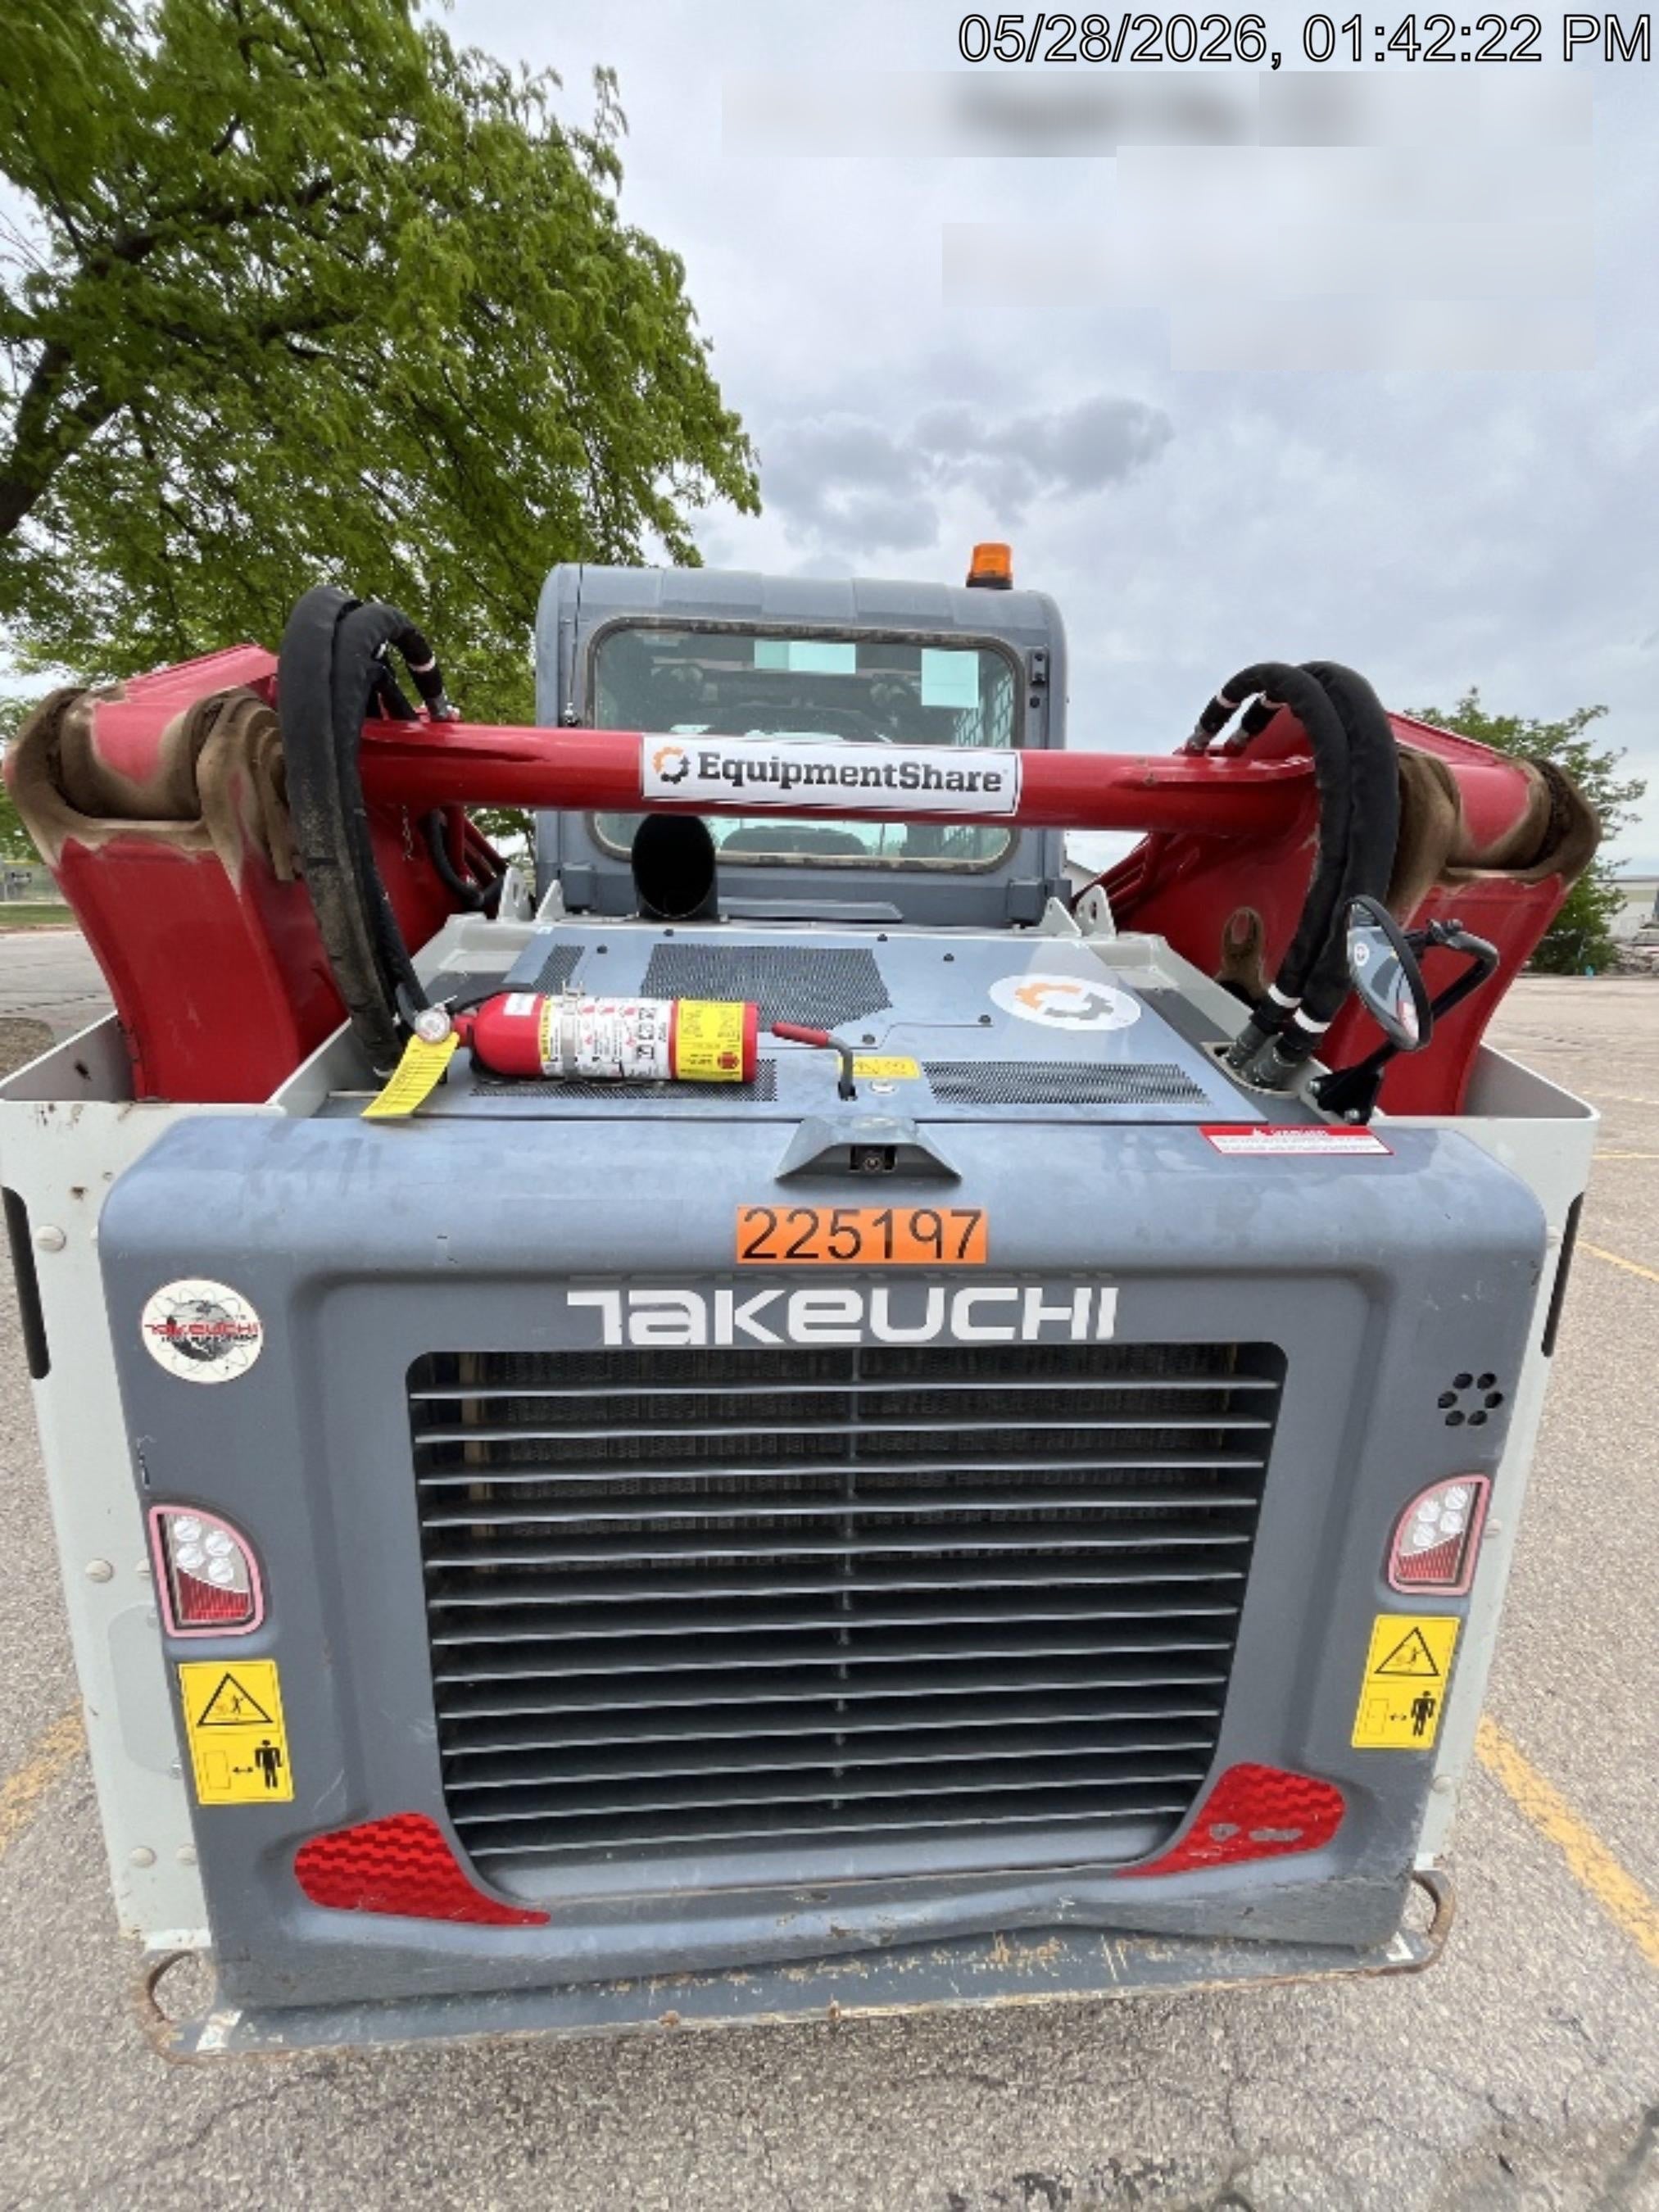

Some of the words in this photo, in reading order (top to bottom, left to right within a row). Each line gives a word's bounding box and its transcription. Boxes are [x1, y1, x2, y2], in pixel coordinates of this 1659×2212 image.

[696, 750, 1003, 792] EquipmentShare
[741, 1208, 982, 1259] 225197
[567, 1287, 1119, 1345] TAKEUCHI
